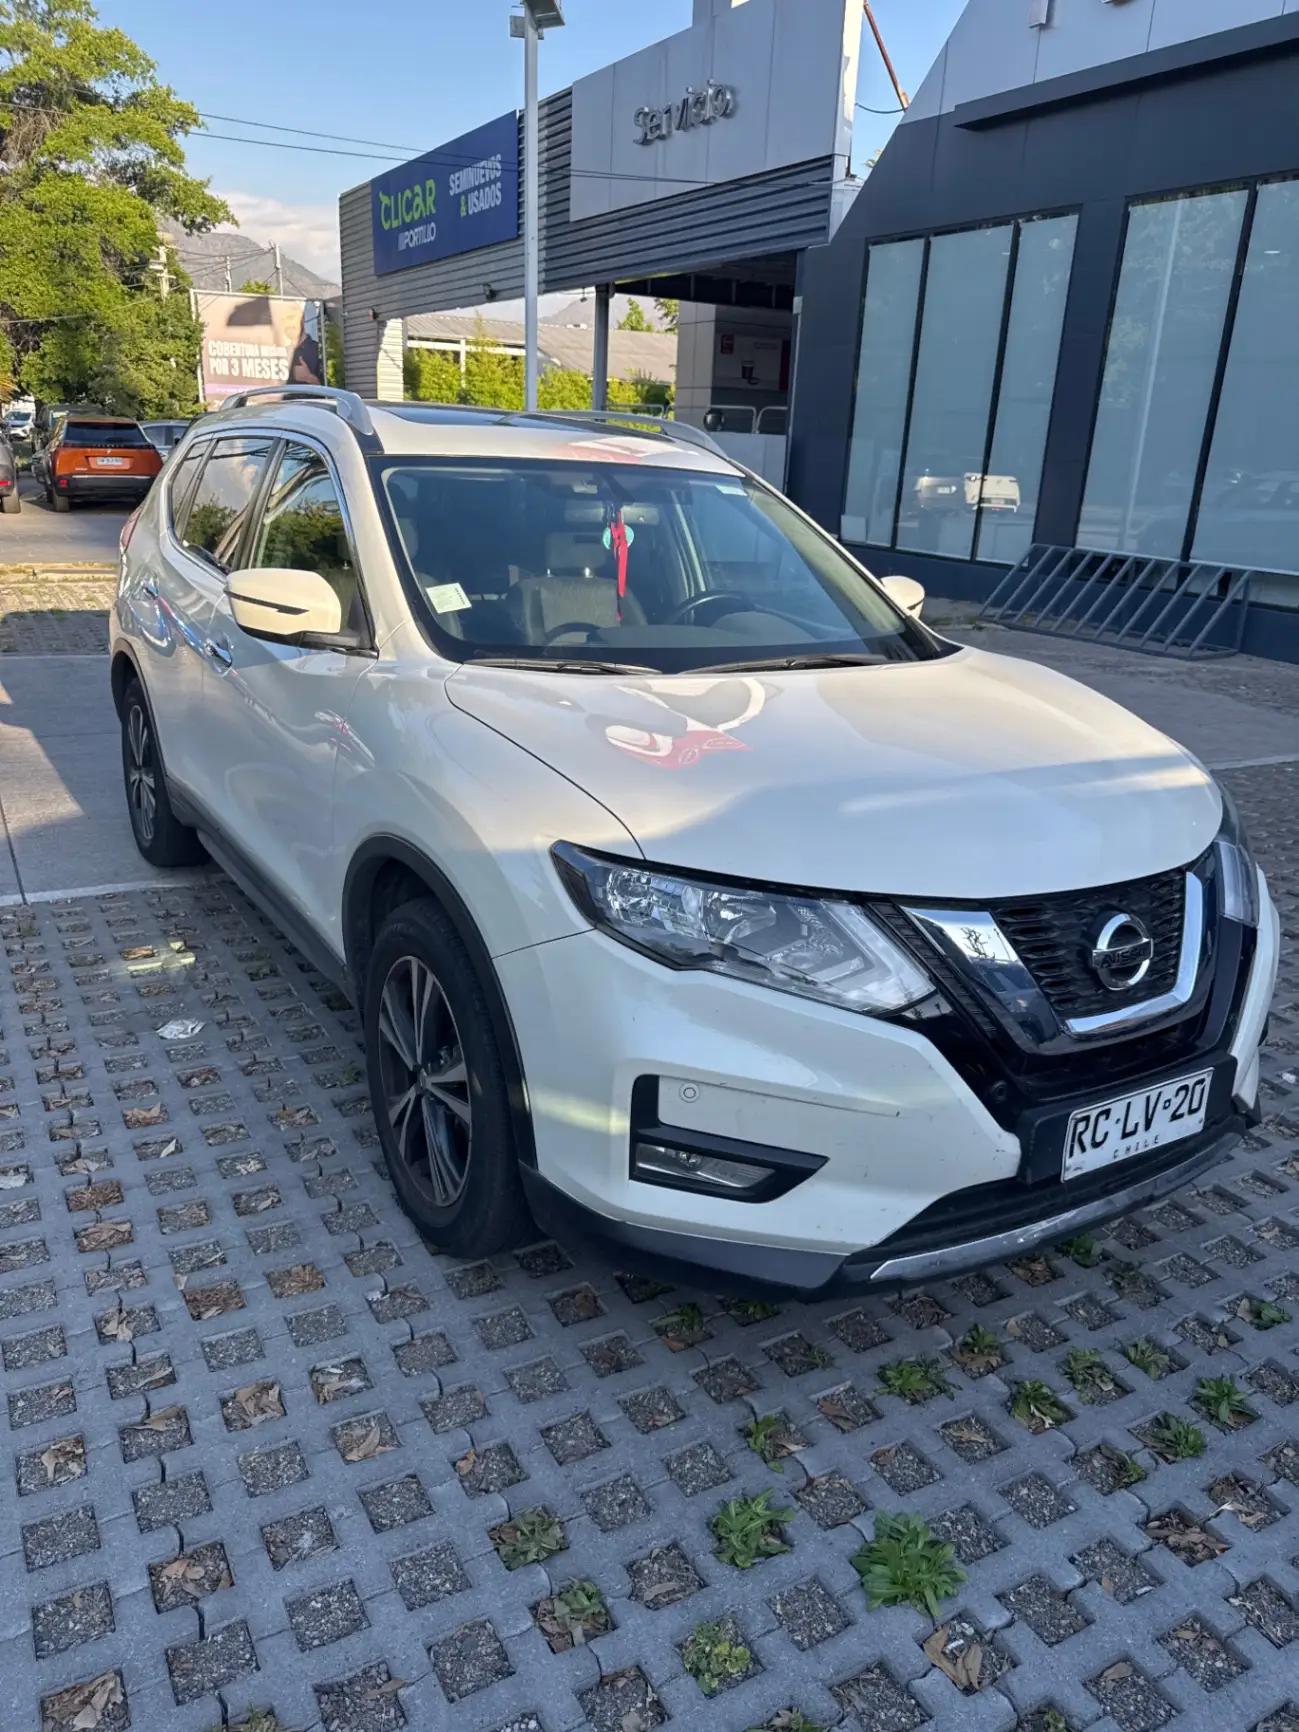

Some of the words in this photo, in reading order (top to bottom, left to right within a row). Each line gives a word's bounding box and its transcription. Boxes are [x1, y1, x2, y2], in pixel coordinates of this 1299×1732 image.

[449, 154, 501, 196] SEMINUEVOS
[468, 182, 501, 215] USADOS
[210, 358, 229, 376] POR
[231, 358, 239, 377] 3
[242, 359, 289, 381] MESES
[1113, 1135, 1160, 1159] CHILE
